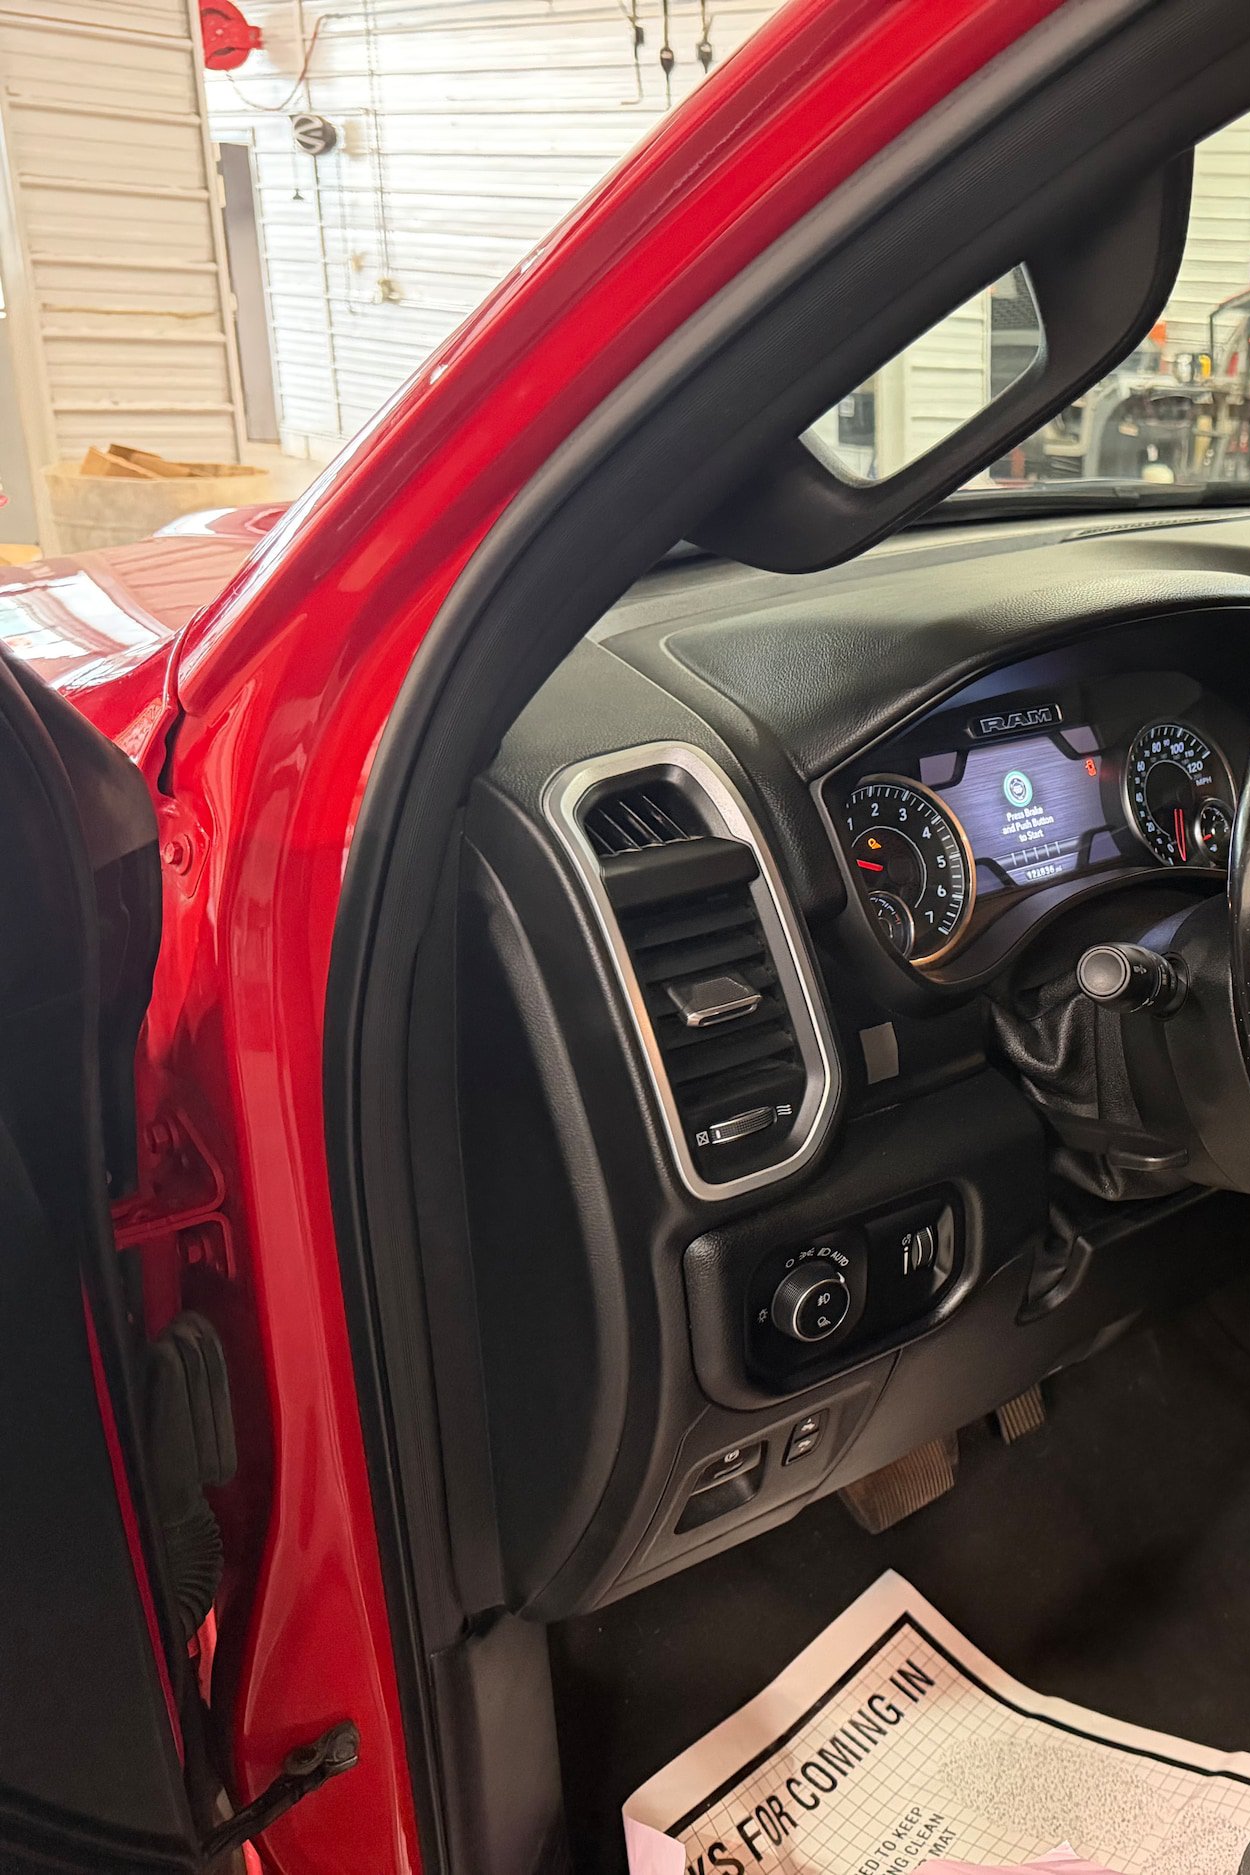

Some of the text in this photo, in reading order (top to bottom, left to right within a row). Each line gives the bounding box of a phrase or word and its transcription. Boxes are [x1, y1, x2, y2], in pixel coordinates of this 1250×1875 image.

[980, 707, 1053, 734] RAM
[1152, 741, 1162, 753] 80
[1170, 742, 1185, 755] 100
[1187, 760, 1203, 773] 120
[1195, 776, 1212, 786] MPH
[871, 803, 879, 817] 2
[899, 808, 908, 822] 3
[1006, 805, 1044, 822] Press Brake
[847, 817, 854, 831] 1
[1002, 815, 1055, 835] and Push Button
[922, 826, 932, 839] 4
[1018, 829, 1045, 842] to Start
[936, 855, 947, 868] 5
[936, 885, 947, 897] 6
[924, 911, 935, 924] 7
[830, 1250, 850, 1267] AUTO
[736, 1795, 799, 1862] FOR
[785, 1693, 905, 1811] COMING
[889, 1659, 936, 1703] IN
[874, 1840, 897, 1858] TO
[892, 1806, 923, 1840] KEEP
[904, 1813, 946, 1856] CLEAN
[928, 1826, 957, 1857] MAT
